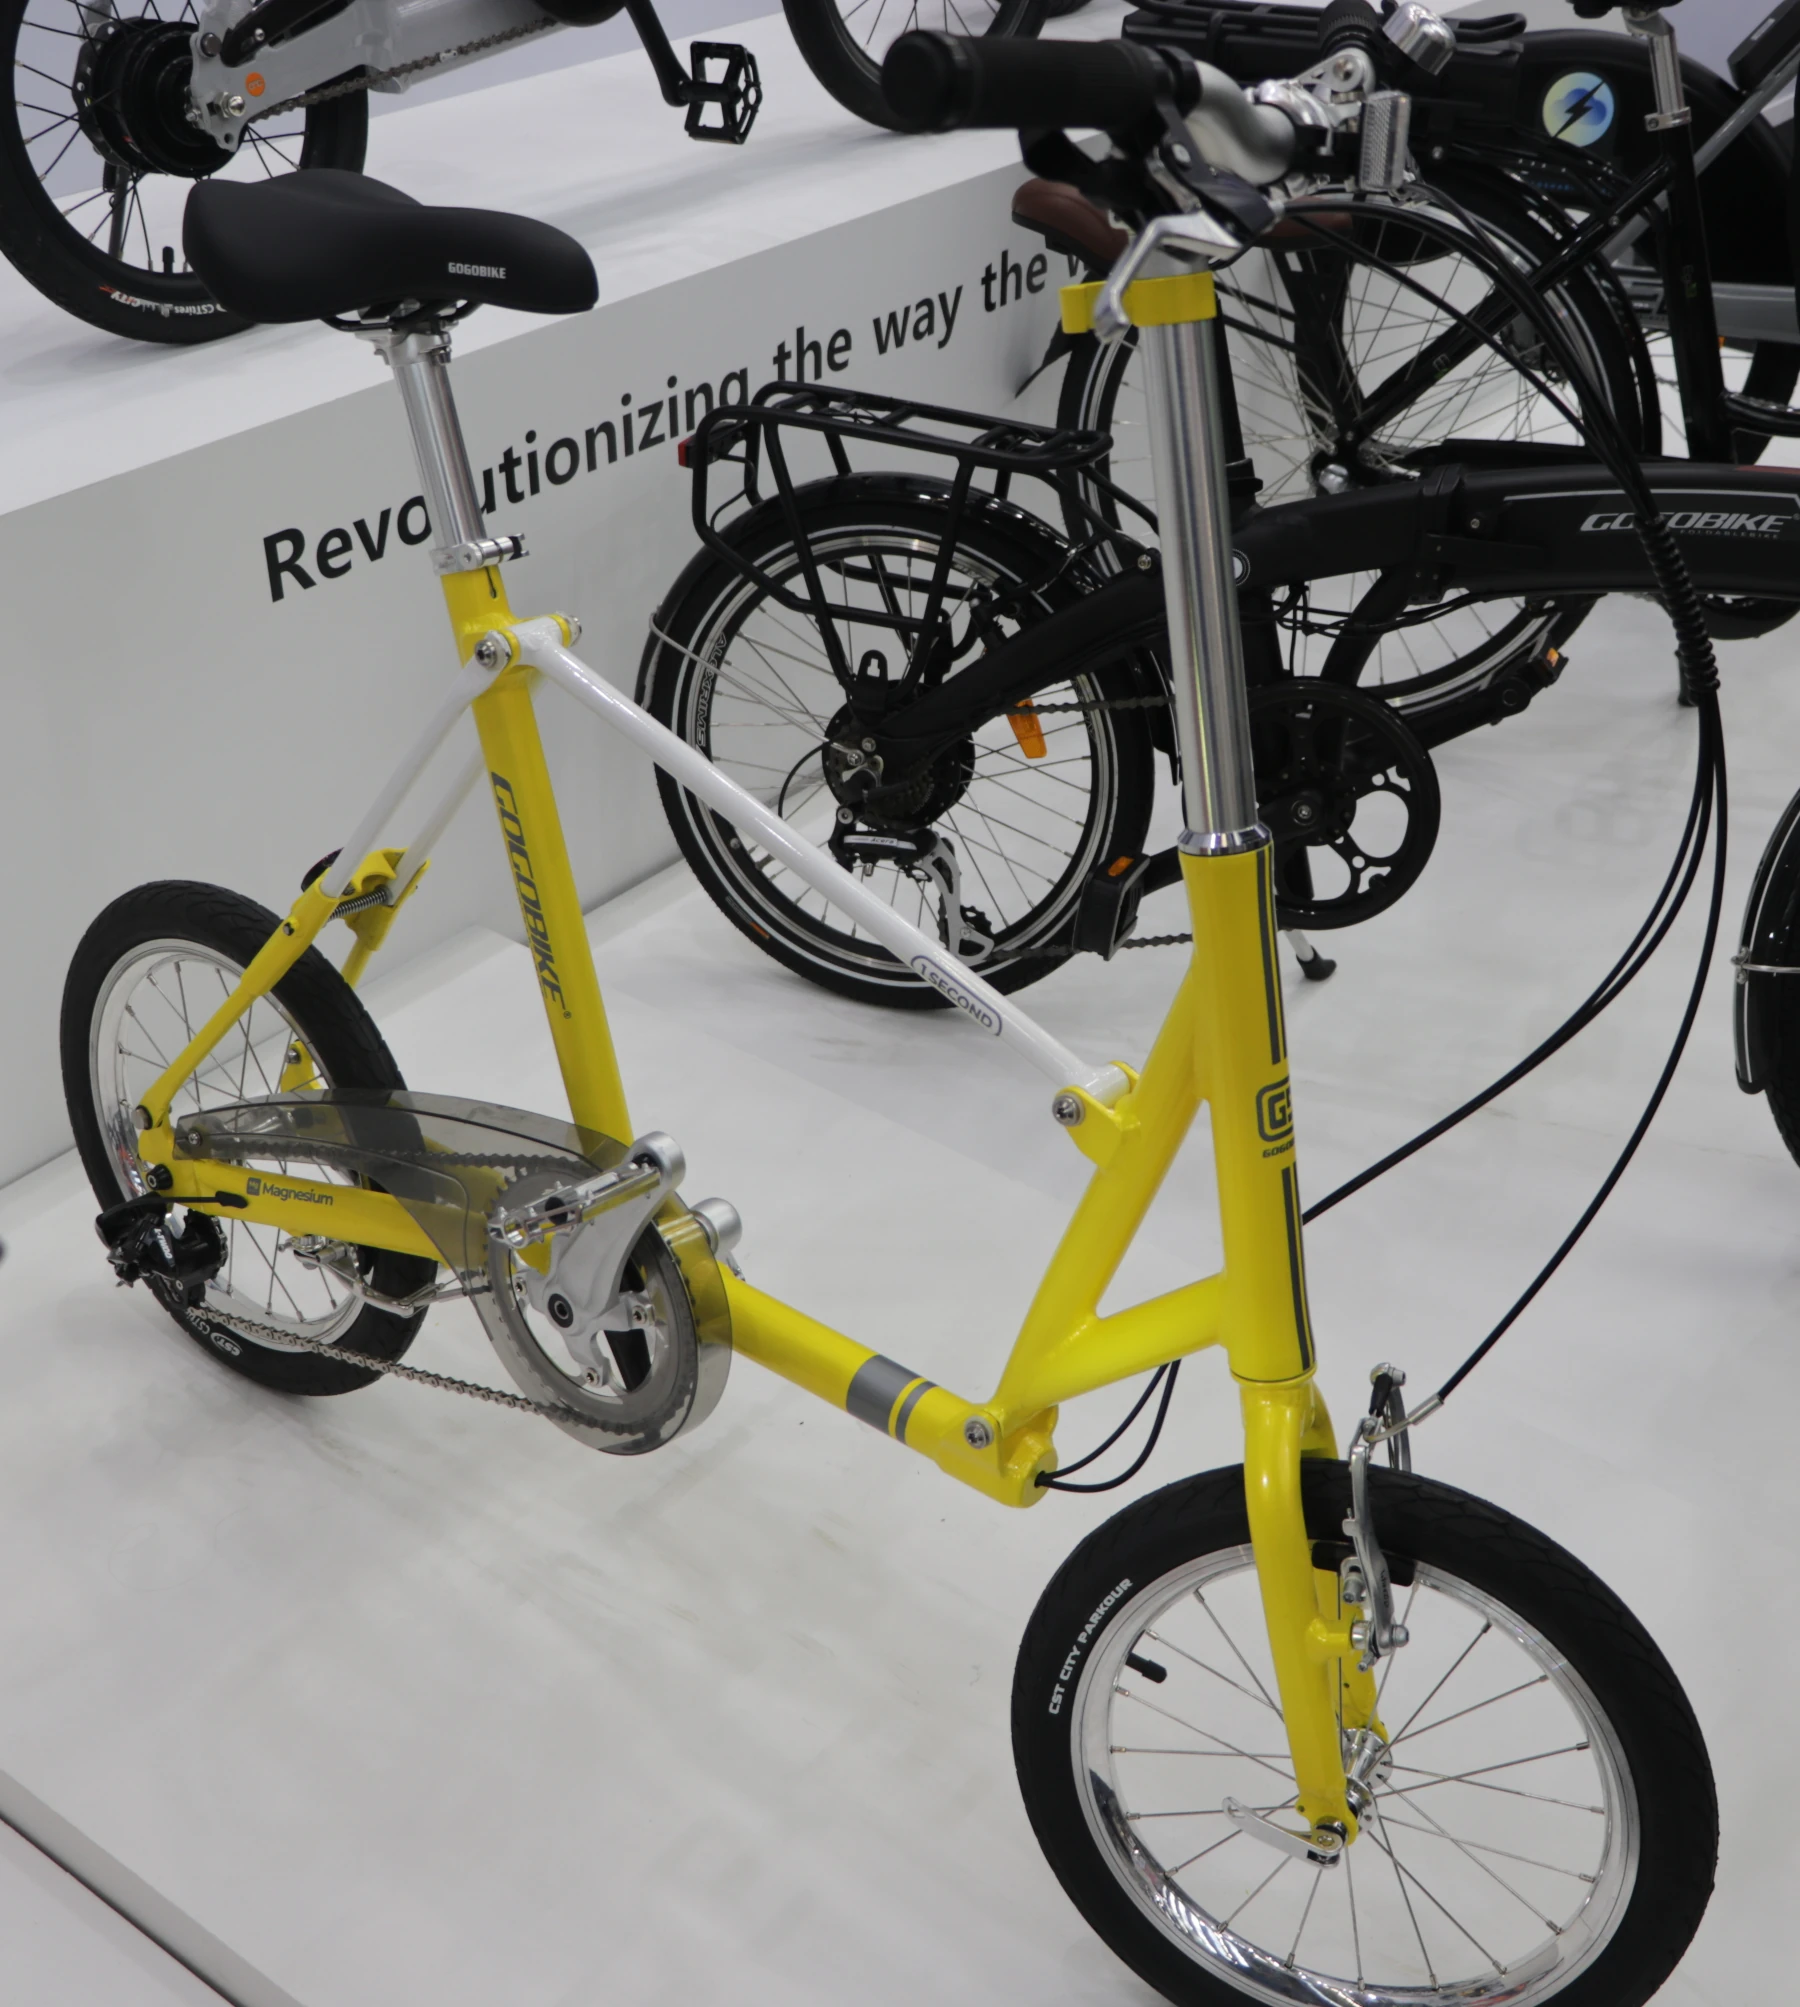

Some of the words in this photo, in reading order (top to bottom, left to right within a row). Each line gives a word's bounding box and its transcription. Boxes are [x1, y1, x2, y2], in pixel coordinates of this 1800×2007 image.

[447, 261, 507, 279] GOGOBIKE
[773, 325, 852, 382] the
[872, 284, 963, 356] way
[980, 248, 1048, 312] the
[490, 771, 567, 1011] GOGOBIKE
[920, 963, 928, 976] 1
[929, 971, 993, 1028] SECOND
[262, 1182, 334, 1206] Magnesium
[1049, 1683, 1066, 1715] CST
[1059, 1645, 1081, 1681] CITY
[1076, 1577, 1134, 1644] PARKOUR
